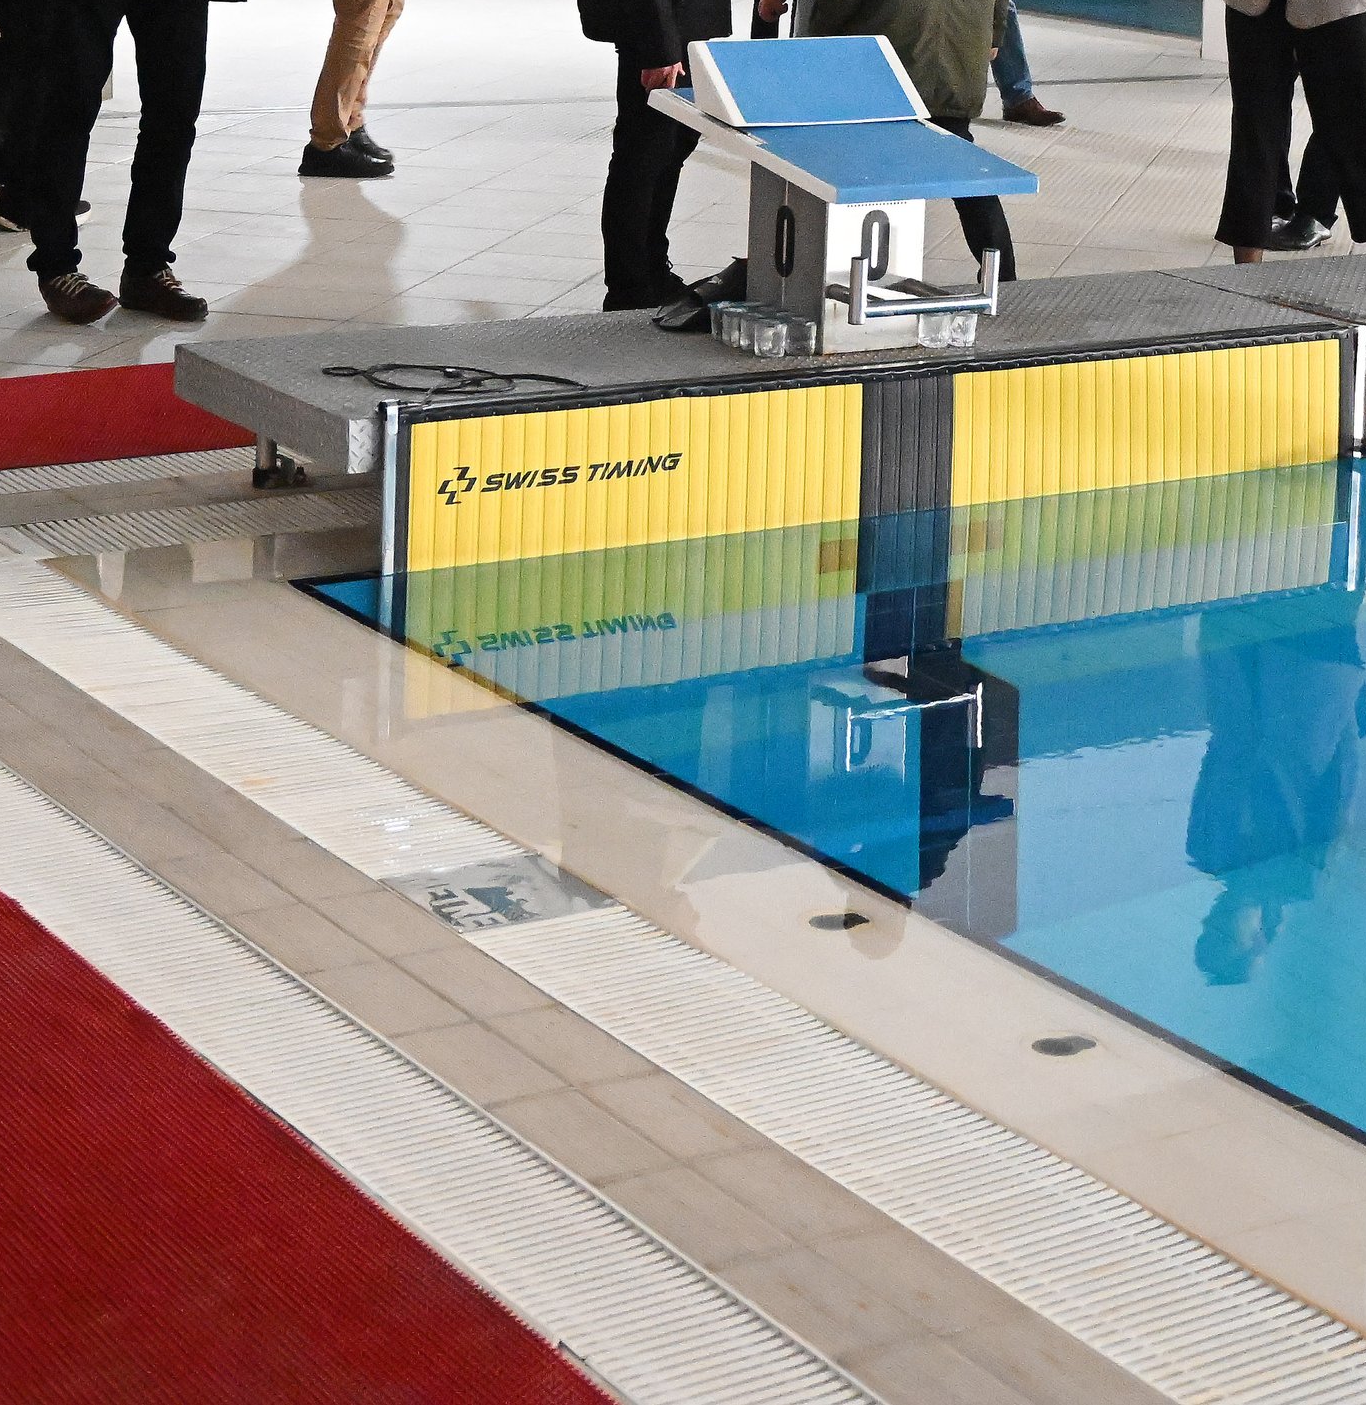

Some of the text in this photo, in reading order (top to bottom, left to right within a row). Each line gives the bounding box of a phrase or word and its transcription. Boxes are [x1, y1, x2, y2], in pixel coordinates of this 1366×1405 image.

[774, 205, 795, 278] 0
[861, 209, 890, 282] 0
[481, 452, 683, 493] SWISS TIMING
